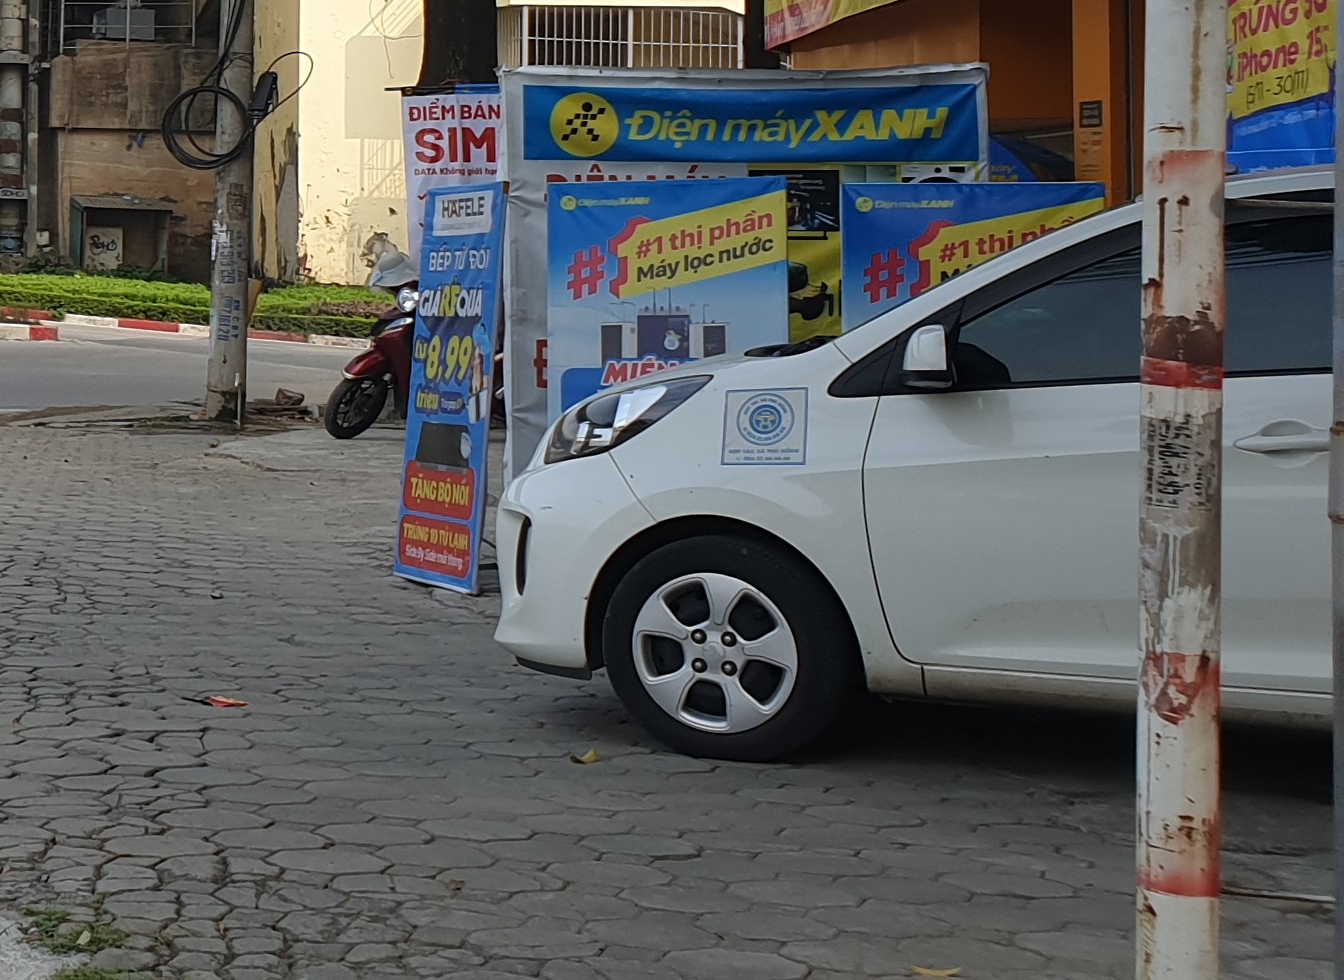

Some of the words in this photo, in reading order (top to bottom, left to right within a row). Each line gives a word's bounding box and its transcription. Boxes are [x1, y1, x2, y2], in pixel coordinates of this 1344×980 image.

[1236, 40, 1300, 83] iPhone
[1306, 23, 1330, 62] 15
[408, 98, 455, 121] ĐIỂM
[460, 101, 501, 120] BÁN
[415, 127, 496, 164] SIM
[624, 109, 716, 149] Điện
[414, 168, 437, 176] DATA
[439, 167, 466, 177] Không
[467, 168, 482, 177] giới
[636, 235, 662, 259] #1
[668, 224, 704, 251] thị
[709, 210, 774, 247] phần
[939, 238, 970, 263] #1
[429, 242, 451, 271] BẾP
[636, 258, 680, 283] Máy
[683, 251, 715, 275] lọc
[718, 236, 775, 264] nước
[425, 335, 473, 383] 8,99
[411, 473, 437, 504] TẶNG
[437, 477, 451, 508] BỘ
